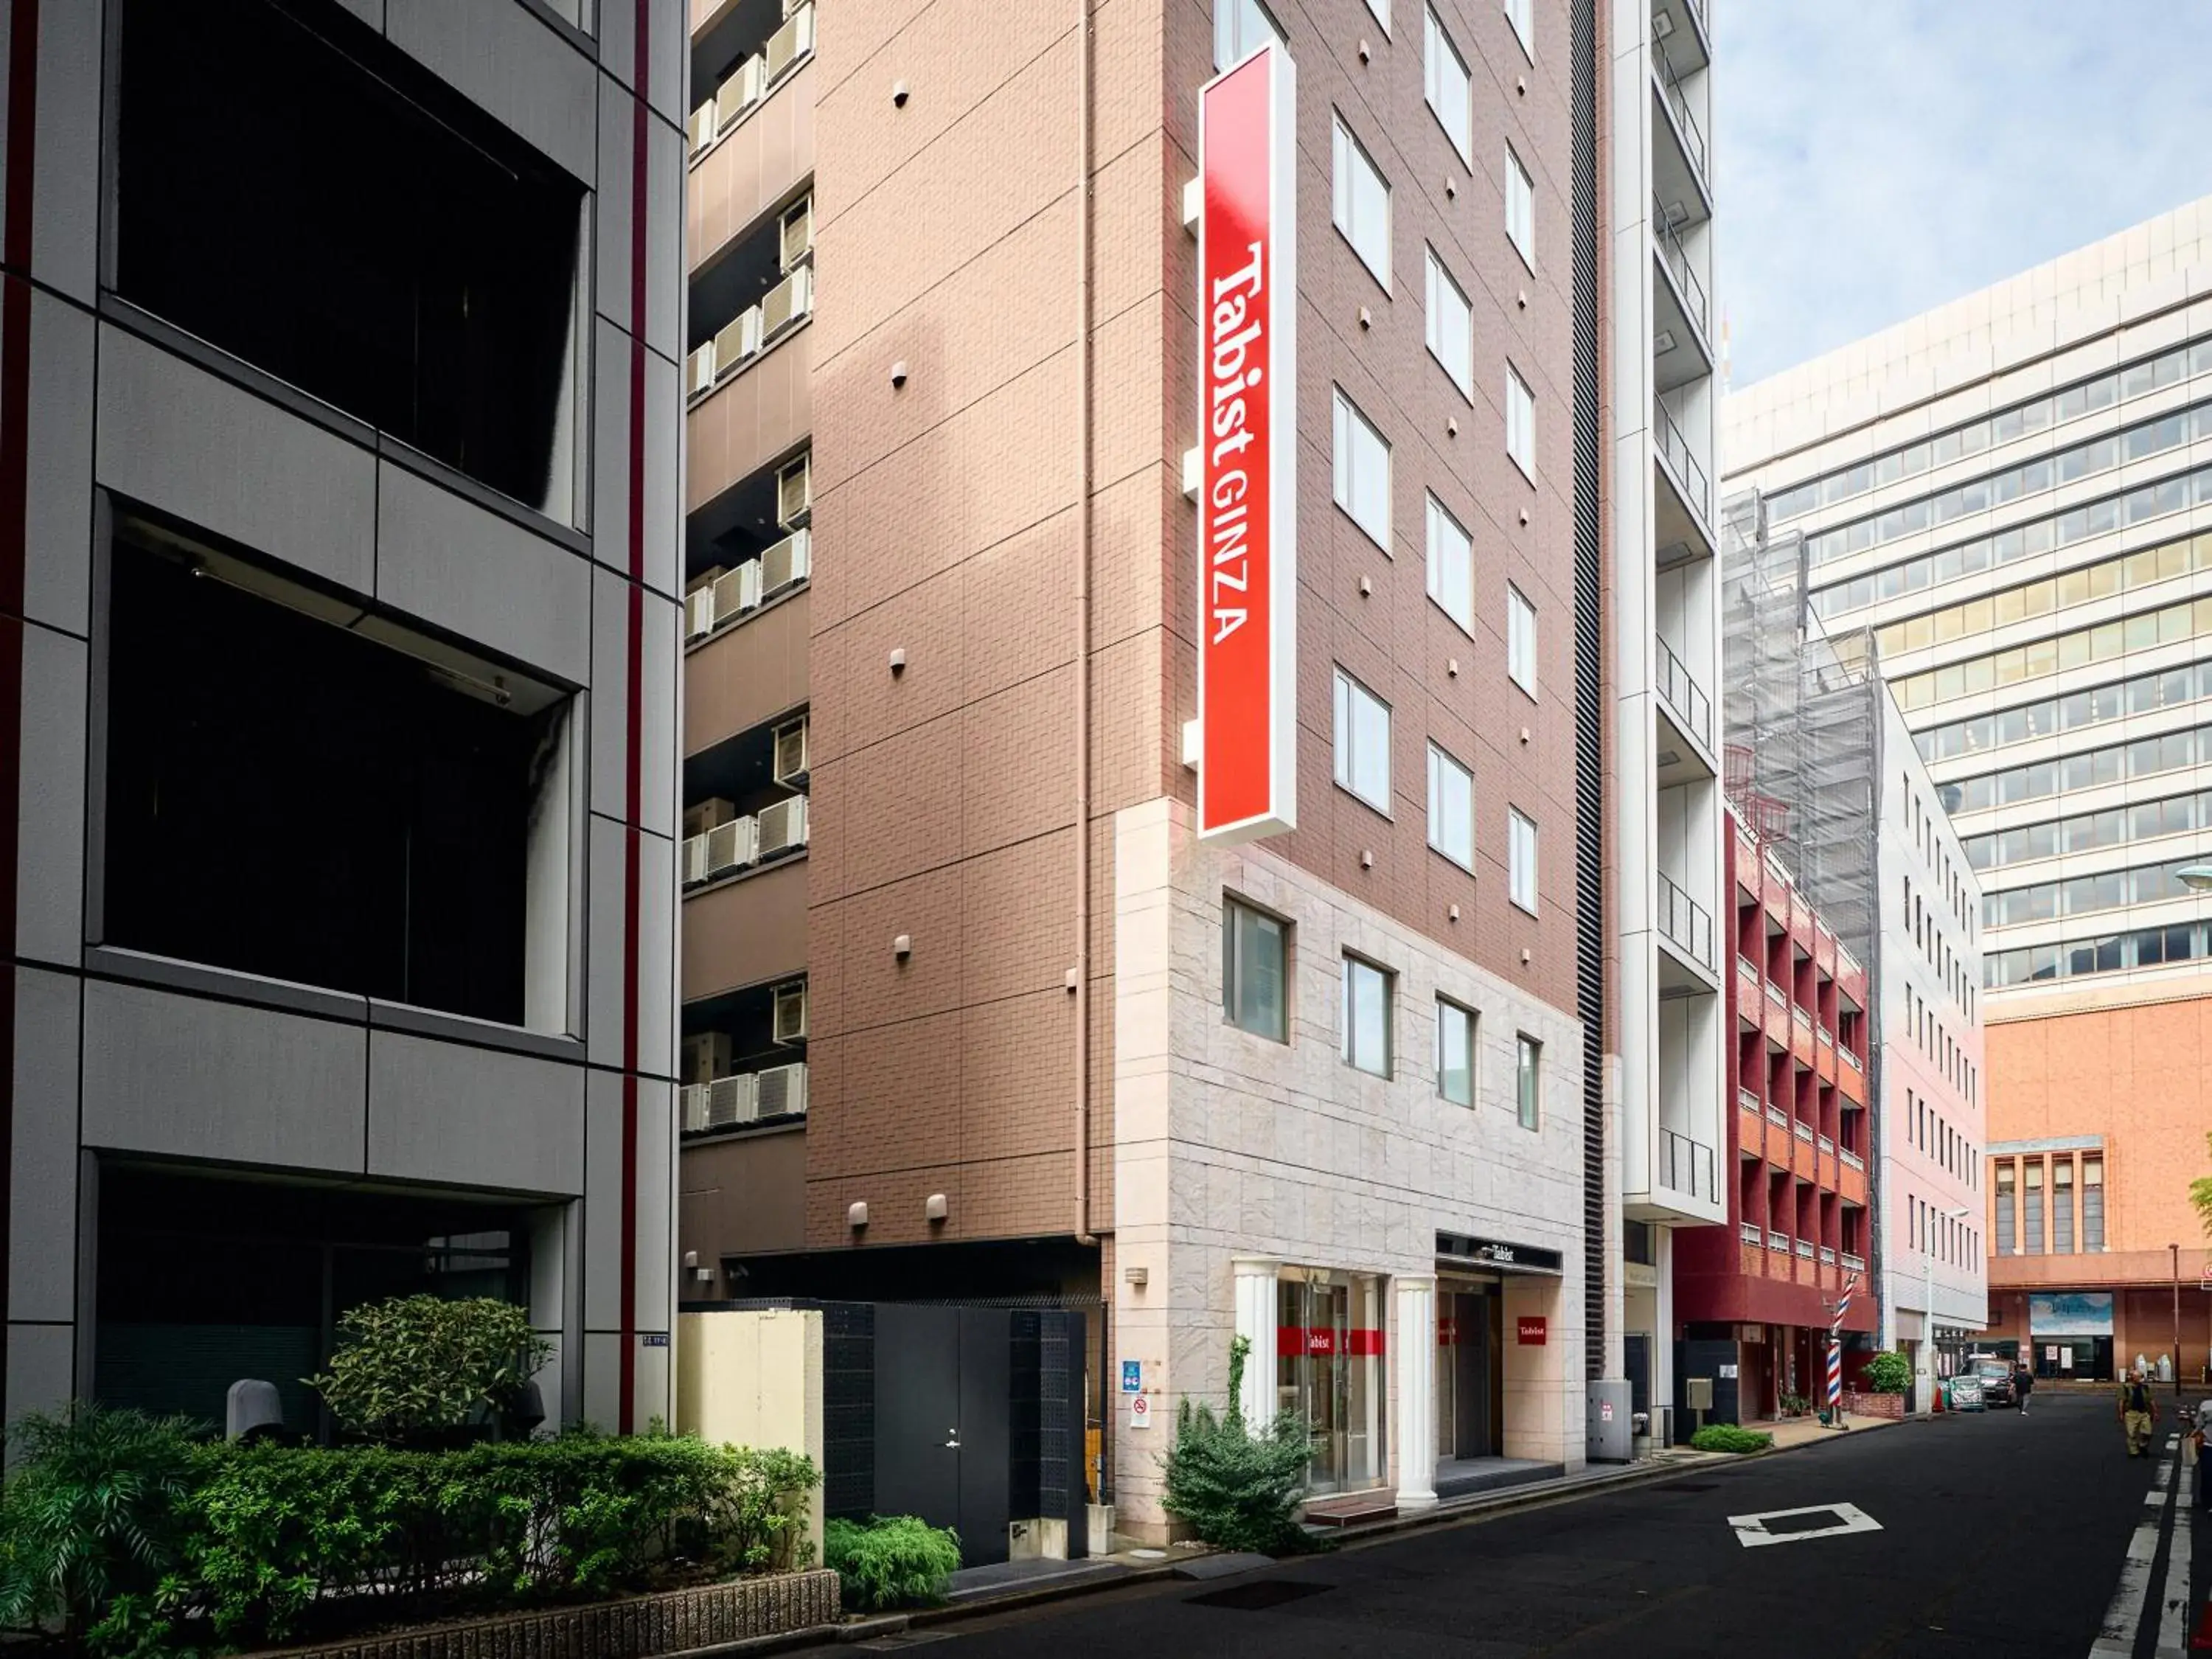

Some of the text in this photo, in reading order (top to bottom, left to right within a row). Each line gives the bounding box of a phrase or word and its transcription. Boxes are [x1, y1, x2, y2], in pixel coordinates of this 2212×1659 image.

[1213, 240, 1262, 646] Tabist GINZA
[1492, 1244, 1514, 1262] Tabist
[1520, 1326, 1545, 1335] Tabist
